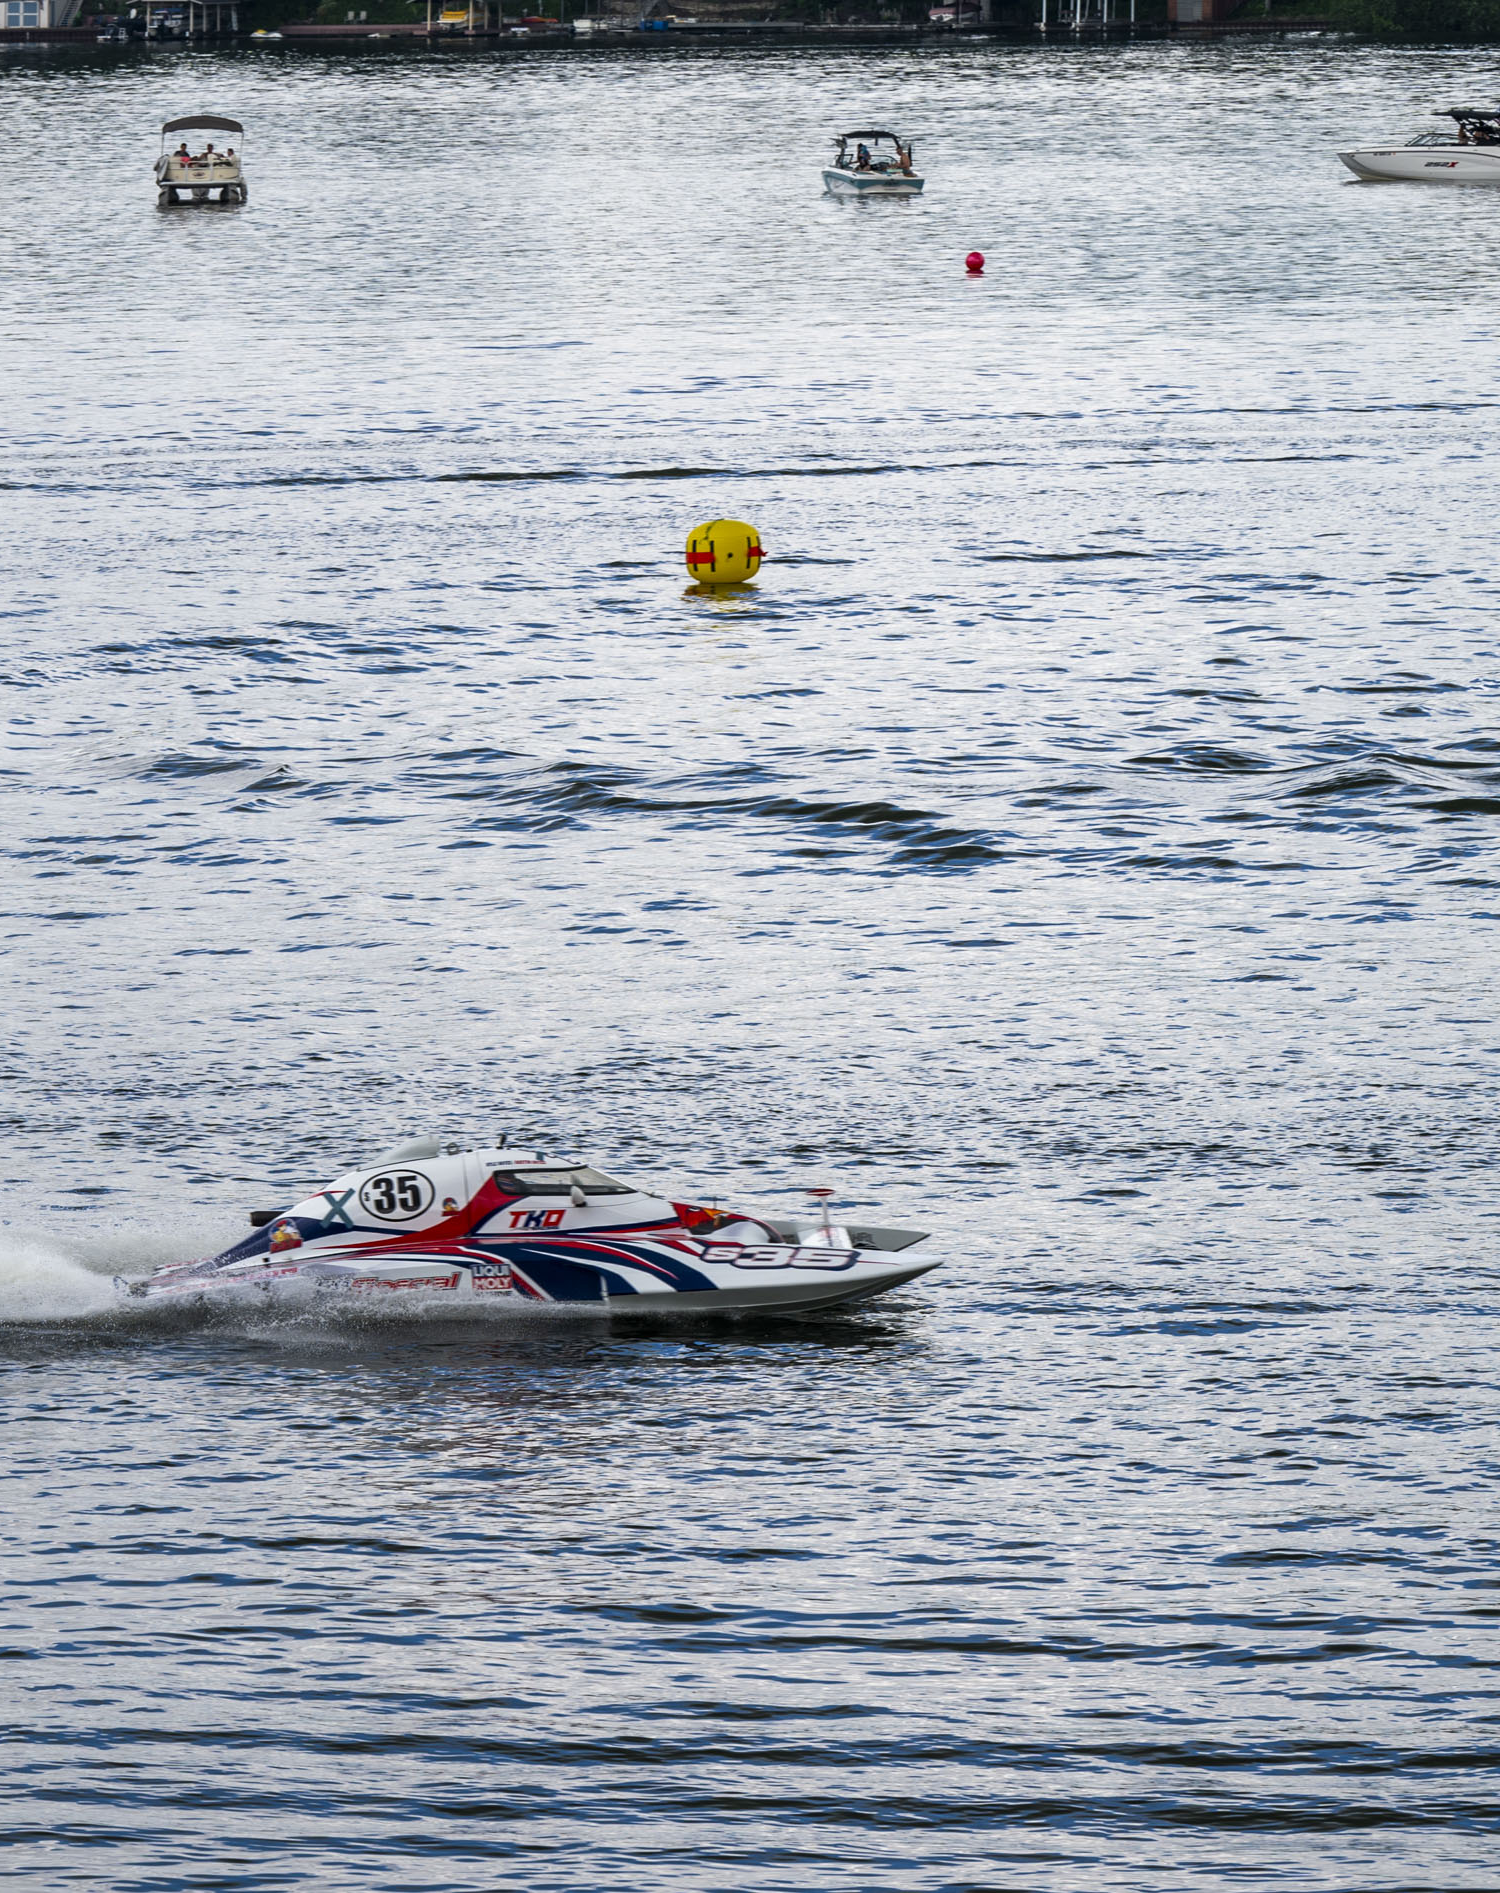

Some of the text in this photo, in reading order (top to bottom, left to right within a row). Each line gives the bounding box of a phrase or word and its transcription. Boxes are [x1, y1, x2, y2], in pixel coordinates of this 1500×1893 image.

[372, 1175, 422, 1215] 35
[508, 1209, 567, 1229] TKO
[472, 1265, 510, 1277] LIQUI
[473, 1277, 512, 1289] MOLY
